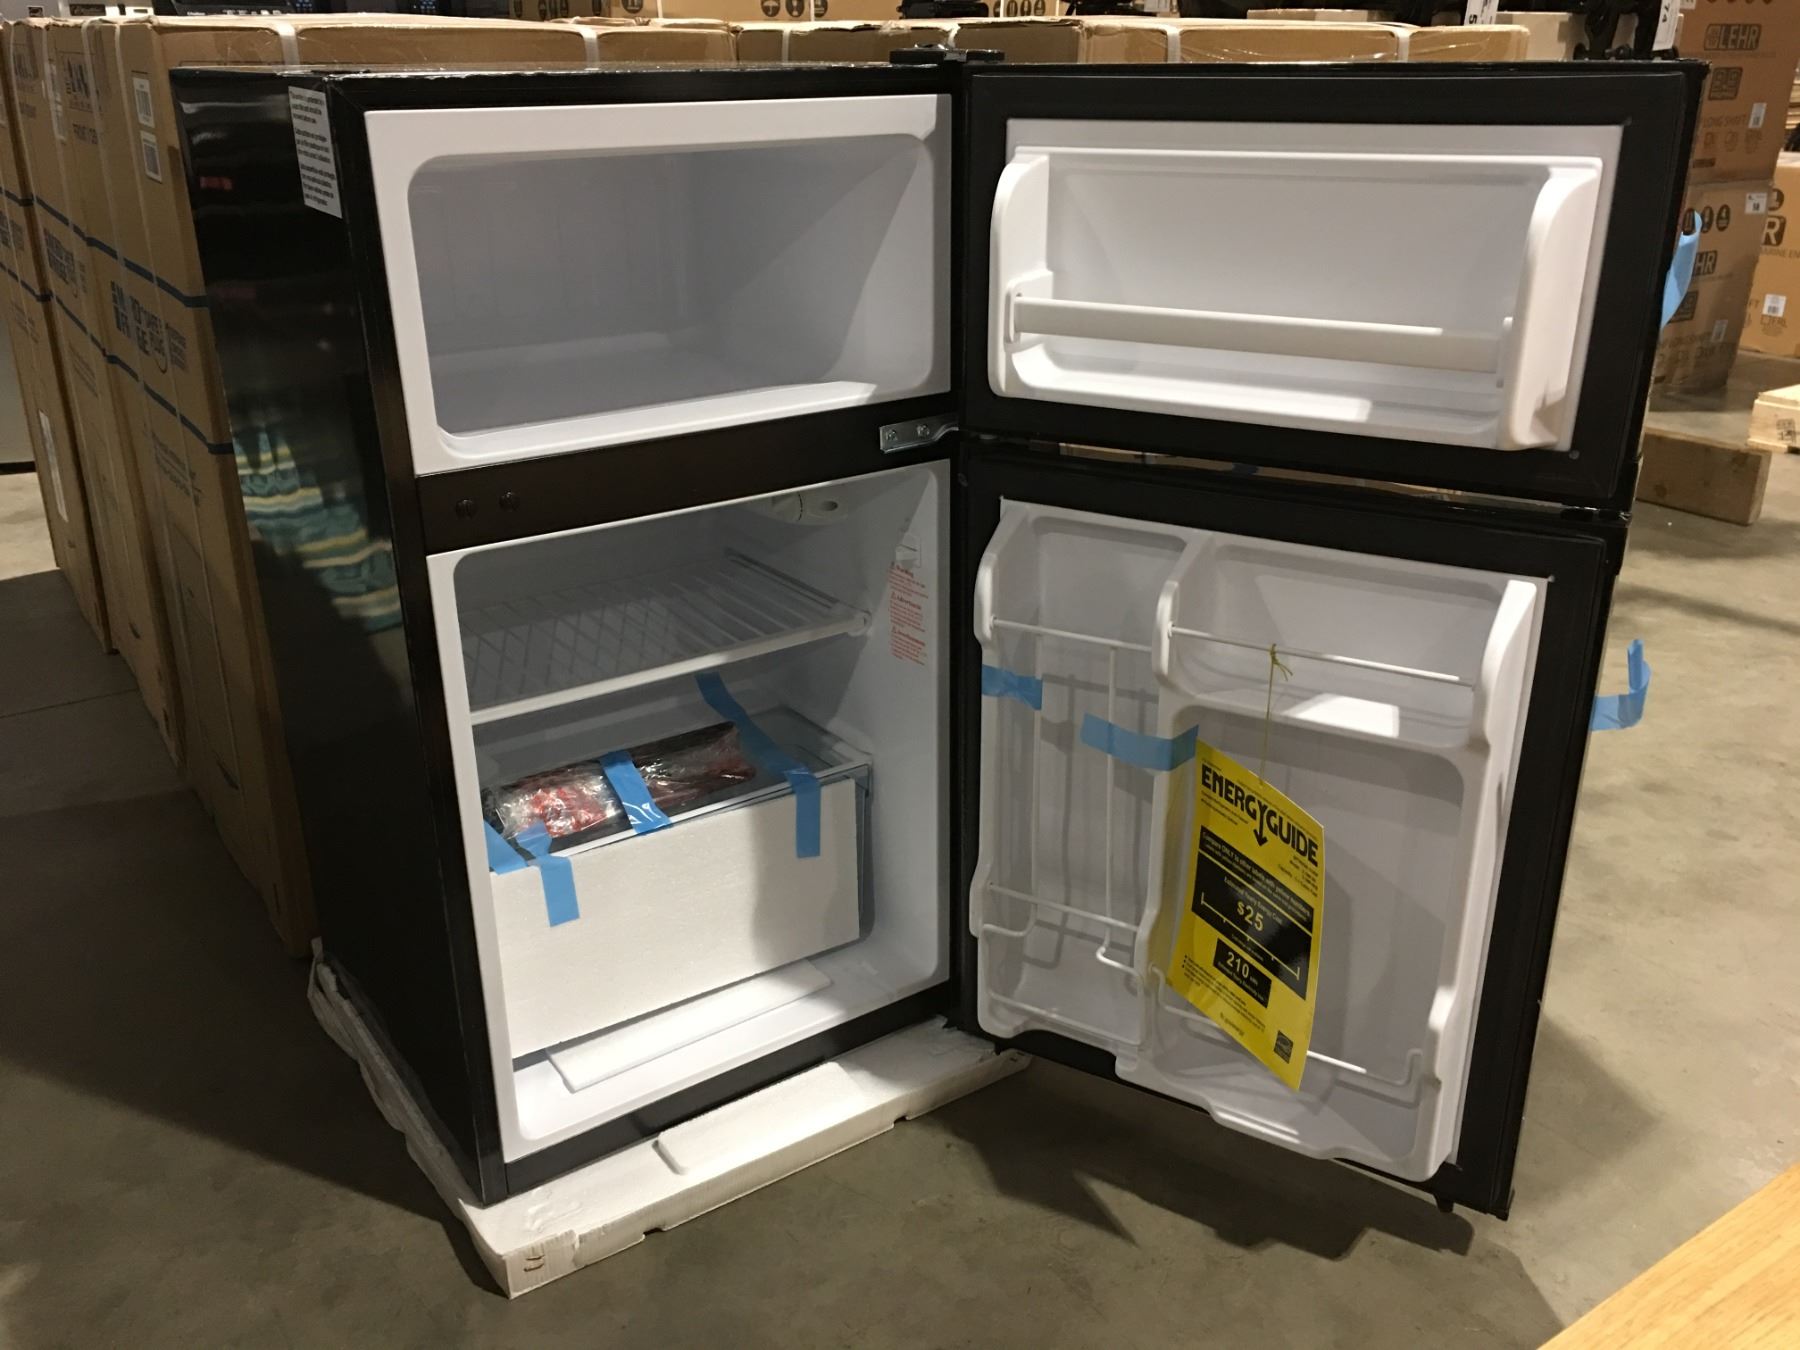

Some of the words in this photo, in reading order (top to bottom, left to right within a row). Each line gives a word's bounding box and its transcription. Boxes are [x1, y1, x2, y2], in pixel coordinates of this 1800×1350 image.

[1718, 25, 1760, 49] LEHR
[1201, 763, 1318, 867] ENERGYGUIDE
[1237, 901, 1263, 931] $25
[1227, 951, 1250, 979] 210
